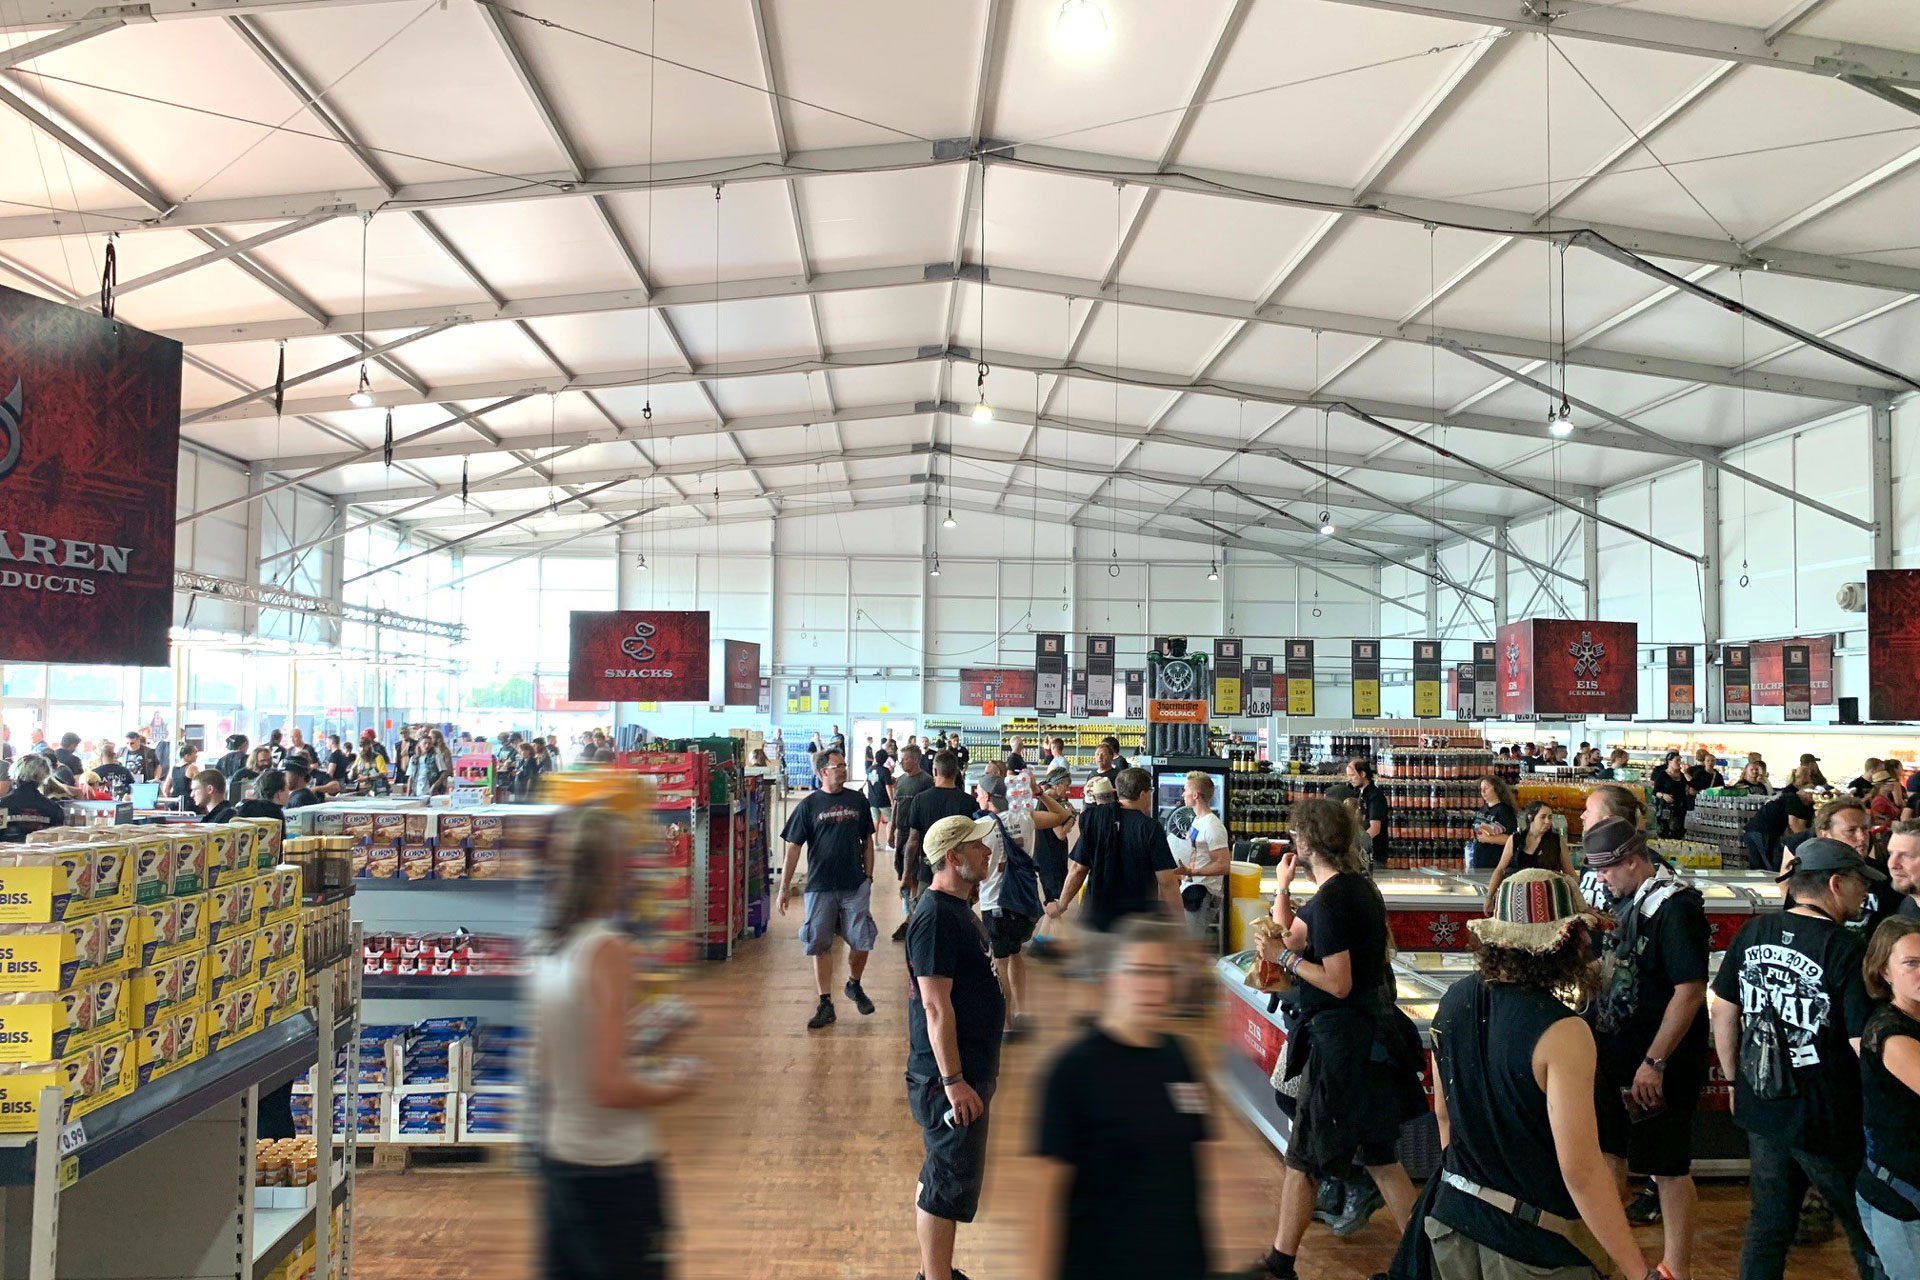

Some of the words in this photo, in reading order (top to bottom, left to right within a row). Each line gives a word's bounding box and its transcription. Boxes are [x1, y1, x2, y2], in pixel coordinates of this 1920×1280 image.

[604, 669, 673, 678] SNACKS
[1508, 681, 1517, 690] EIS
[1576, 680, 1598, 689] EIS
[1252, 701, 1270, 713] 0.89
[1128, 707, 1142, 717] 6.49
[317, 814, 341, 823] CORNY
[345, 814, 370, 824] CORNY
[376, 815, 403, 824] CORNY
[444, 816, 468, 825] CORNY
[473, 818, 498, 827] CORNY
[370, 848, 397, 857] CORNY
[403, 849, 431, 858] CORNY
[438, 849, 461, 858] CORNY
[0, 893, 32, 905] BISS.
[8, 962, 42, 974] BISS.
[1785, 952, 1819, 977] 2019
[1248, 1019, 1262, 1042] EIS
[0, 1032, 33, 1043] BISS.
[1, 1102, 36, 1114] BISS.
[63, 1128, 83, 1149] 0.99
